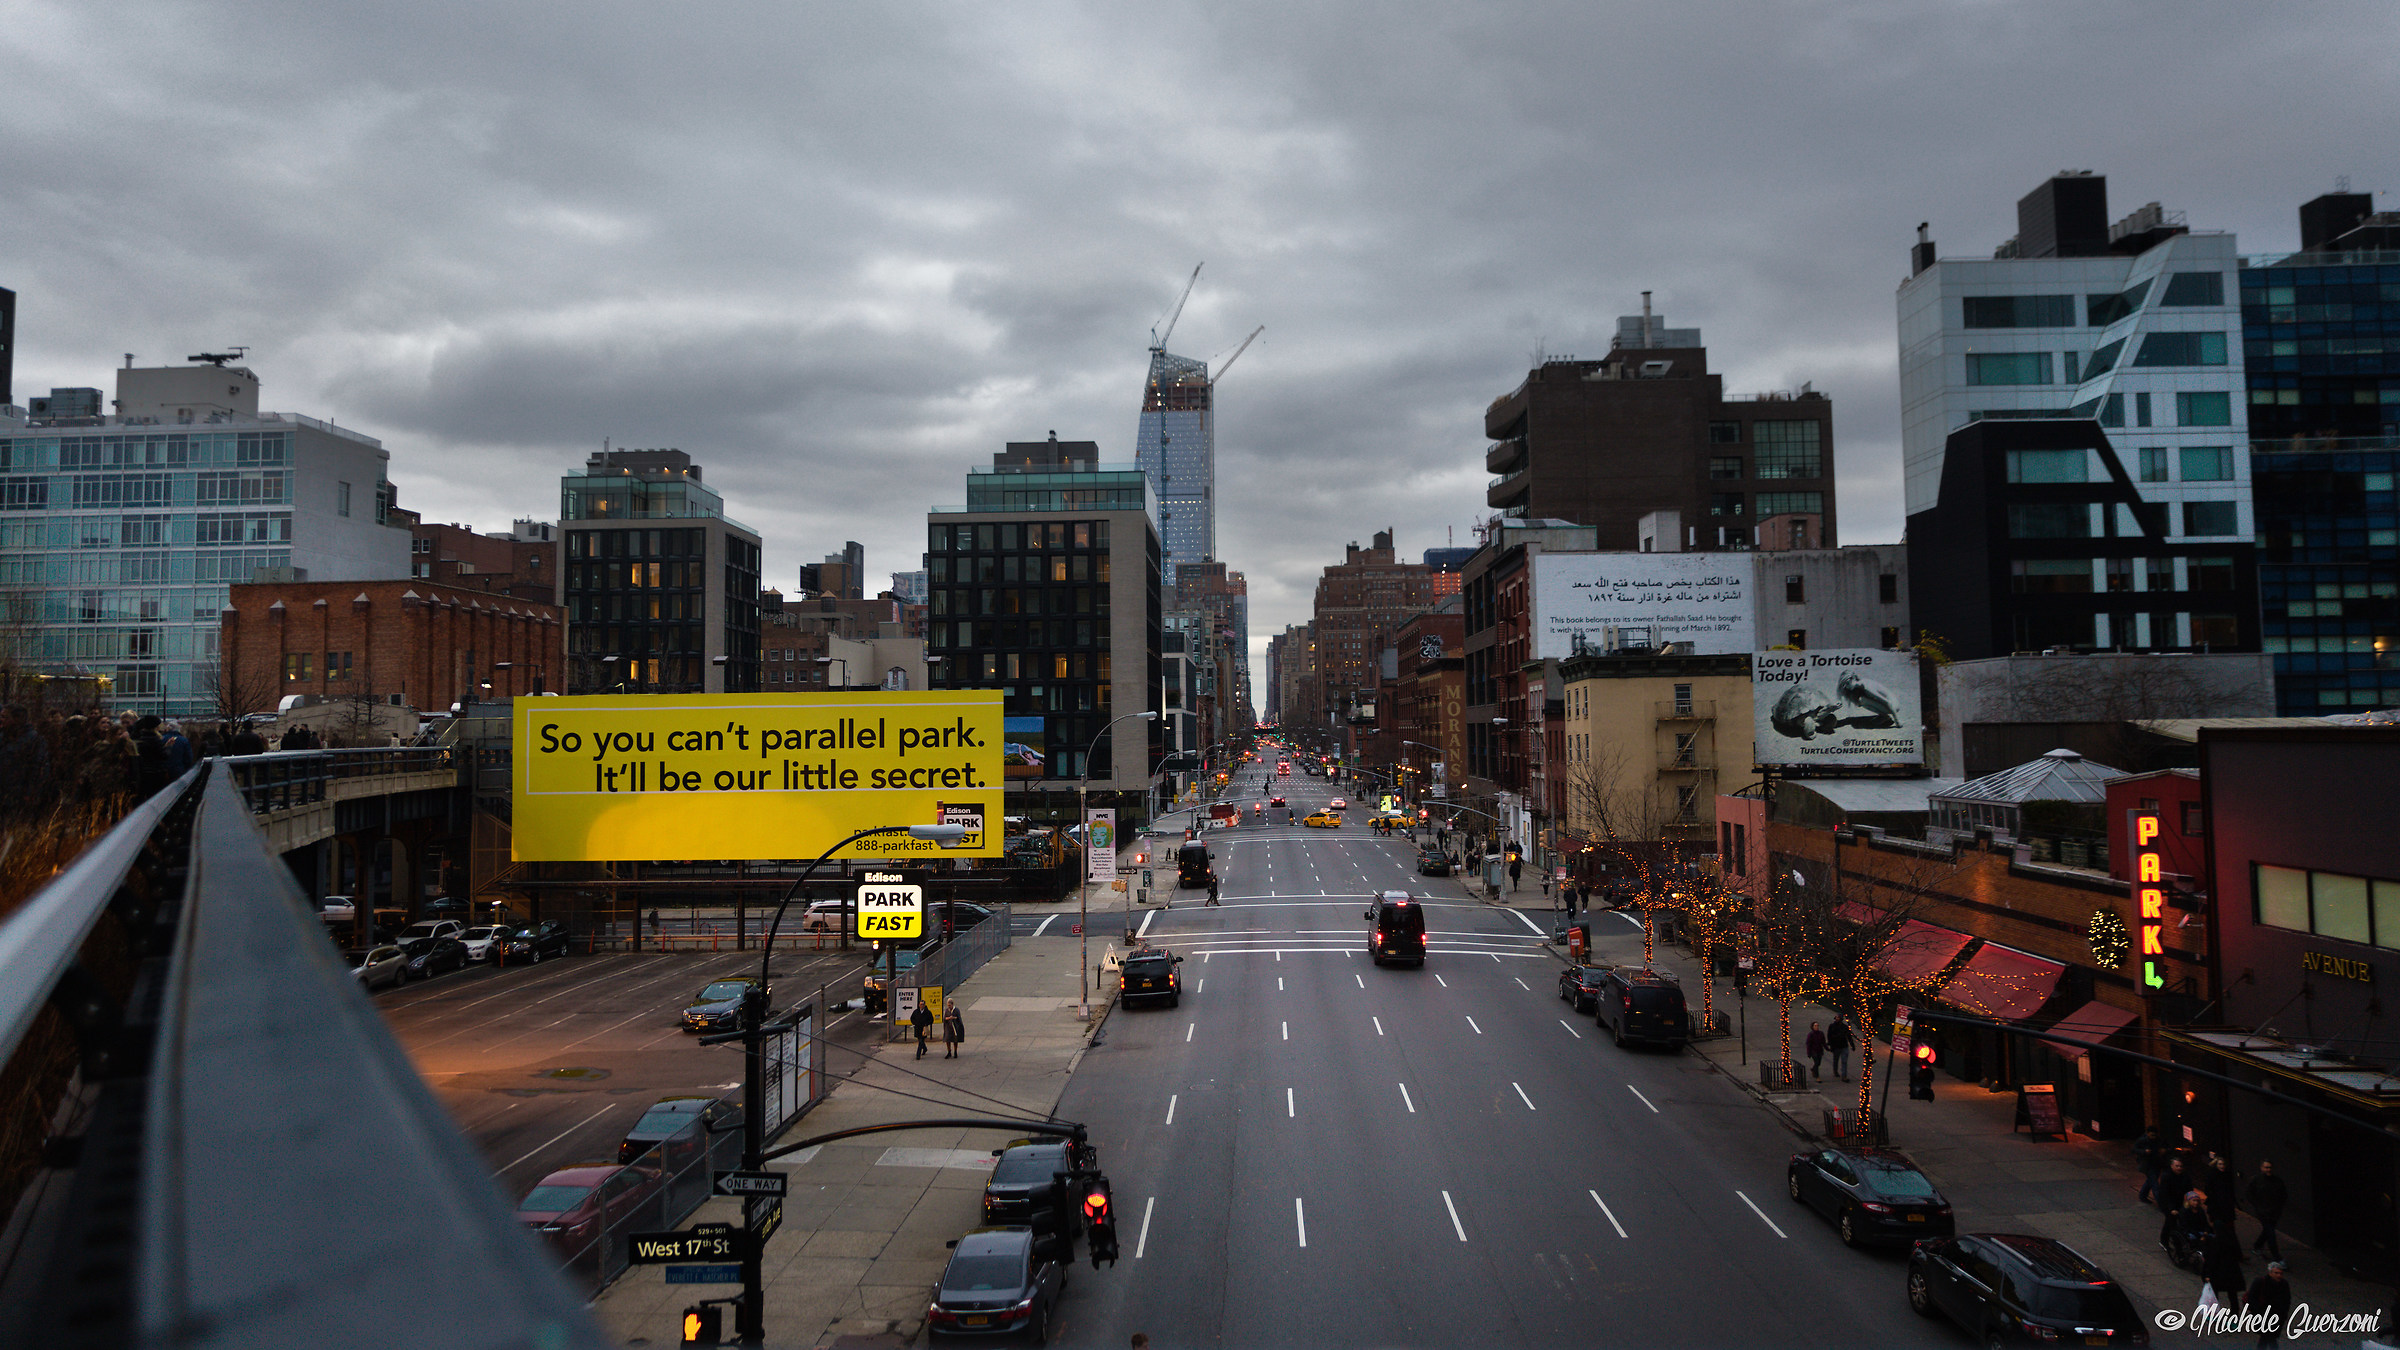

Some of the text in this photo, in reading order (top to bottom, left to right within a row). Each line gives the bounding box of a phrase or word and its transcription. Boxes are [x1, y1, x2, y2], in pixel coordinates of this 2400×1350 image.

[1695, 576, 1723, 589] الكتاب
[1696, 593, 1709, 602] من
[1585, 616, 1611, 624] belongs
[1718, 614, 1742, 623] bought
[1690, 624, 1712, 632] March
[1758, 653, 1873, 668] Love a Tortoise
[1758, 669, 1809, 684] Today!
[540, 717, 985, 761] So you can’t parallel park.
[660, 760, 702, 792] be
[713, 768, 771, 790] our
[783, 759, 858, 790] little
[870, 760, 985, 788] secret.
[855, 839, 933, 854] 888-parkfast
[864, 871, 903, 883] Edison
[2137, 816, 2163, 956] PARK
[864, 892, 915, 907] PARK
[865, 916, 914, 931] FAST
[2302, 951, 2371, 982] AVENUE
[726, 1178, 777, 1189] ONE WAY
[637, 1239, 730, 1258] West 17th St
